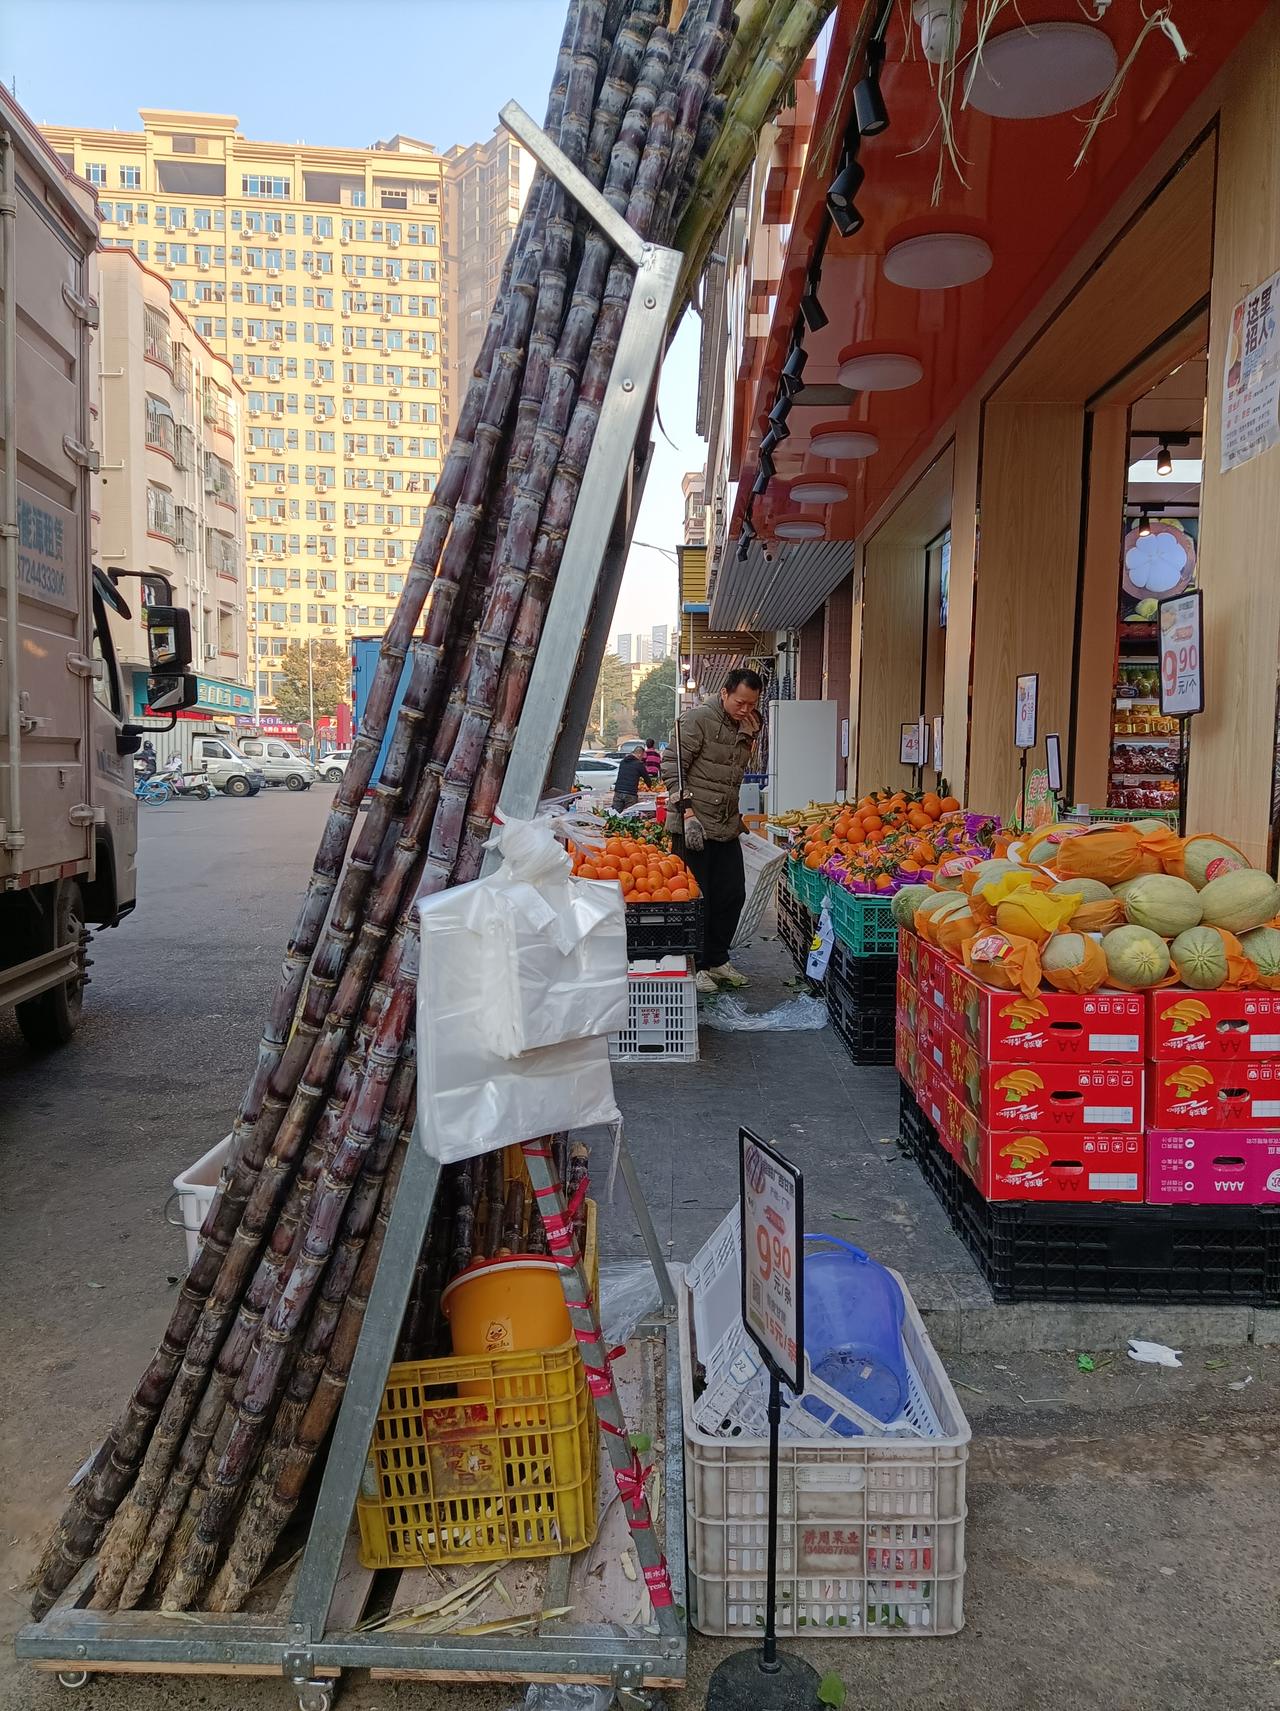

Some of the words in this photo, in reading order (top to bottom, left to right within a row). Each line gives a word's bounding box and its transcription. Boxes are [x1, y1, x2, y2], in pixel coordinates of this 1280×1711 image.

[1246, 284, 1273, 328] 这里
[1245, 317, 1269, 356] 招人
[1162, 649, 1178, 697] 9
[1177, 678, 1197, 696] 元/个
[1214, 1180, 1246, 1192] AAAA
[756, 1224, 771, 1281] 9
[773, 1236, 791, 1280] 90
